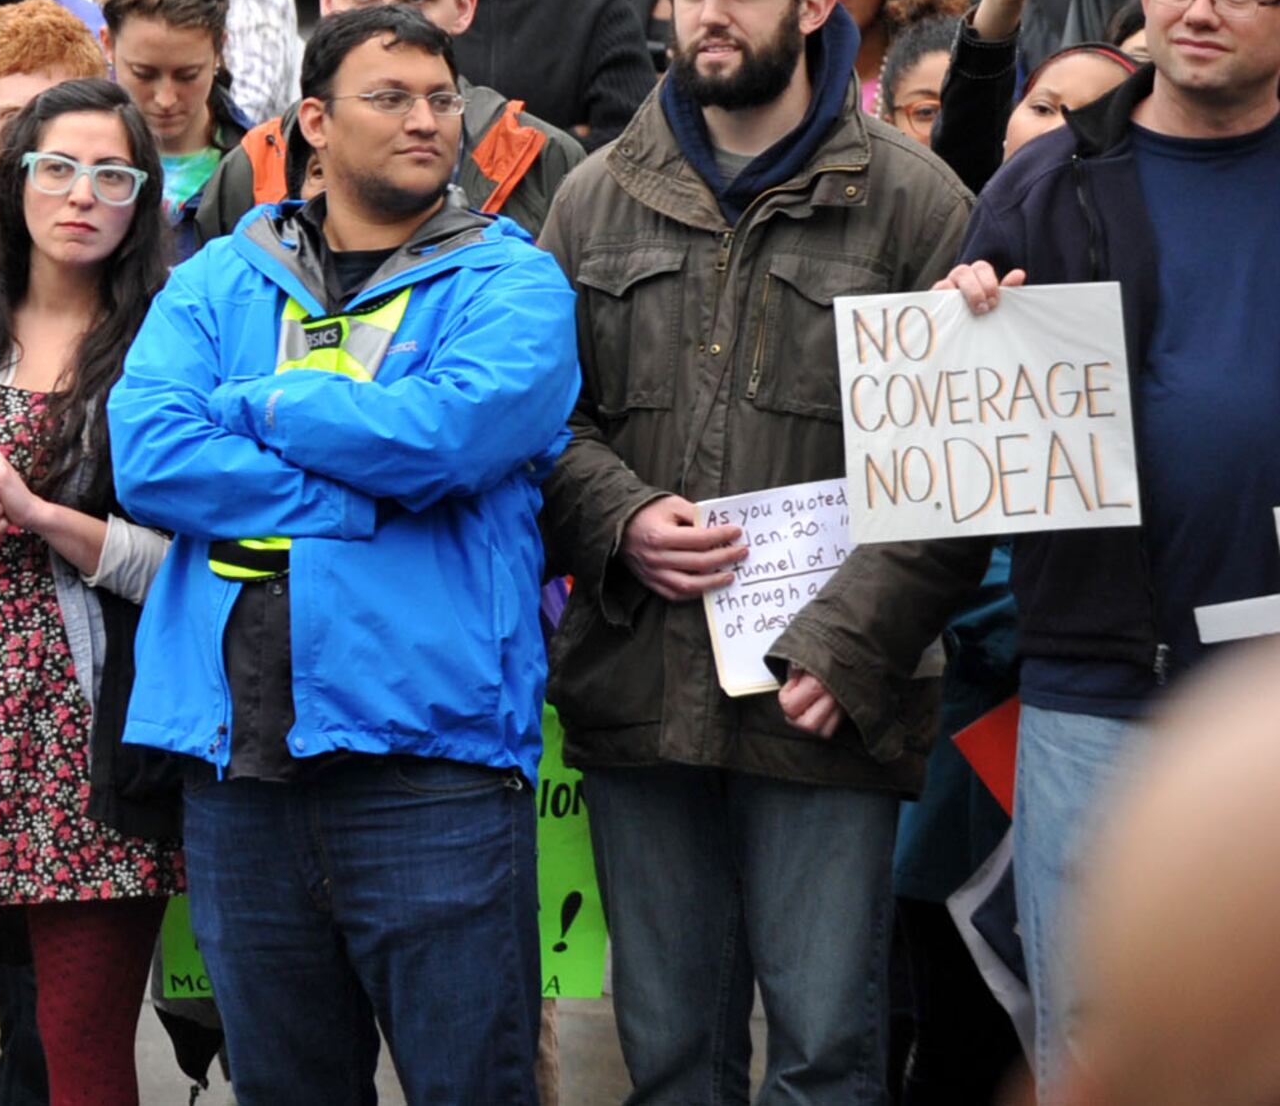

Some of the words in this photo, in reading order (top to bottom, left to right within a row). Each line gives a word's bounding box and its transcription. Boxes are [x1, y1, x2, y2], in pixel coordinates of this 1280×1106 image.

[852, 305, 937, 363] NO
[850, 361, 1116, 433] COVERAGE
[944, 430, 1133, 523] DEAL
[740, 503, 771, 526] you
[782, 486, 848, 517] quoted
[732, 549, 796, 580] tunnel
[807, 547, 824, 567] of
[716, 584, 800, 612] through
[725, 617, 744, 638] of
